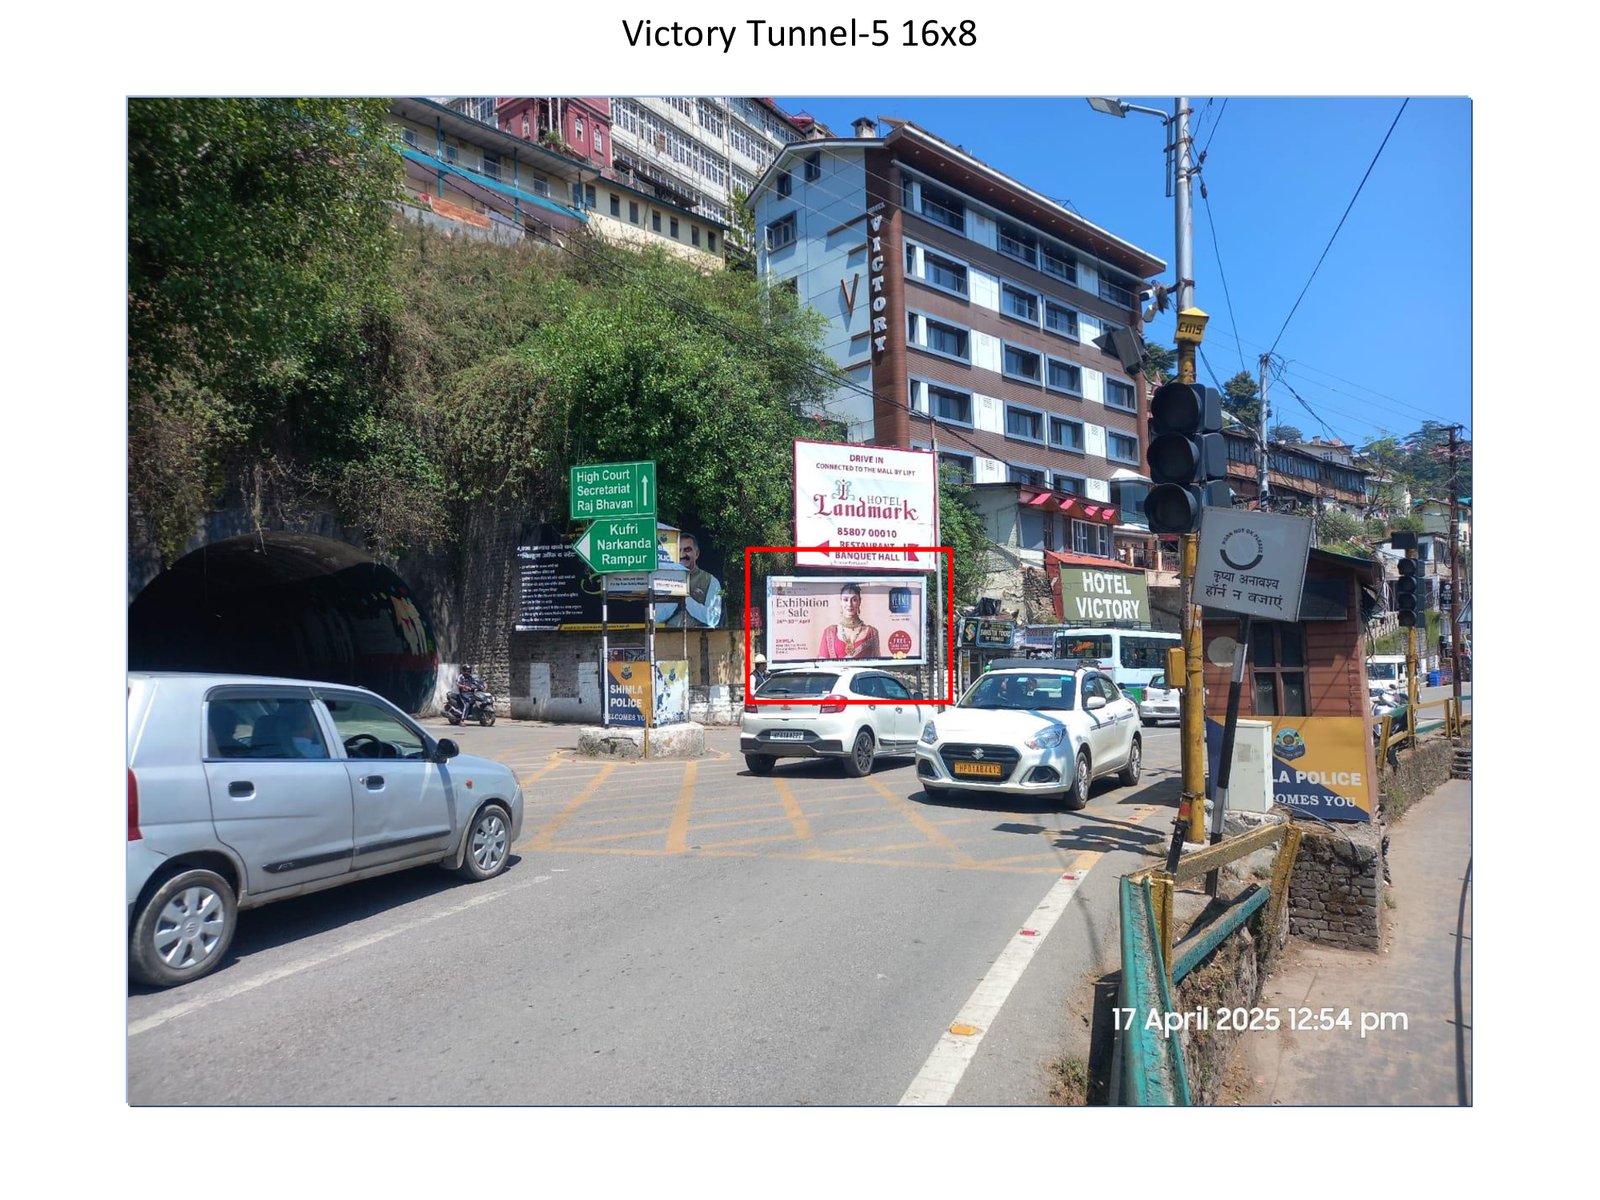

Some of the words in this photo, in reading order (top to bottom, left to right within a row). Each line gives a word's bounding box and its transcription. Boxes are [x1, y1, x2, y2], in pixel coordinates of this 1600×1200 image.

[870, 215, 888, 352] VICTORY
[849, 454, 874, 464] DRIVE
[815, 462, 854, 471] CONNECTED
[864, 466, 876, 474] THE
[877, 467, 893, 475] MALL
[576, 471, 600, 485] High
[602, 469, 630, 481] Court
[576, 483, 631, 497] Secretariat
[577, 500, 594, 513] Raj
[596, 499, 634, 511] Bhavan
[813, 493, 919, 521] Landmark
[867, 495, 902, 507] HOTEL
[609, 523, 639, 536] Kufri
[836, 527, 867, 537] 85807
[868, 528, 898, 539] 00010
[597, 538, 652, 551] Narkanda
[601, 554, 648, 567] Rampur
[835, 551, 877, 561] BANQUET
[878, 552, 901, 562] HALL
[1082, 571, 1132, 595] HOTEL
[1240, 574, 1280, 589] अनावश्य
[1205, 583, 1228, 598] हॉर्न
[1232, 589, 1243, 600] न
[776, 597, 829, 608] Exhibition
[1075, 596, 1141, 620] VICTORY
[788, 607, 809, 618] Sale
[609, 684, 644, 695] SHIMLA
[610, 698, 643, 708] POLICE
[1295, 770, 1362, 787] POLICE
[1273, 793, 1320, 806] OMES
[1323, 795, 1357, 808] YOU
